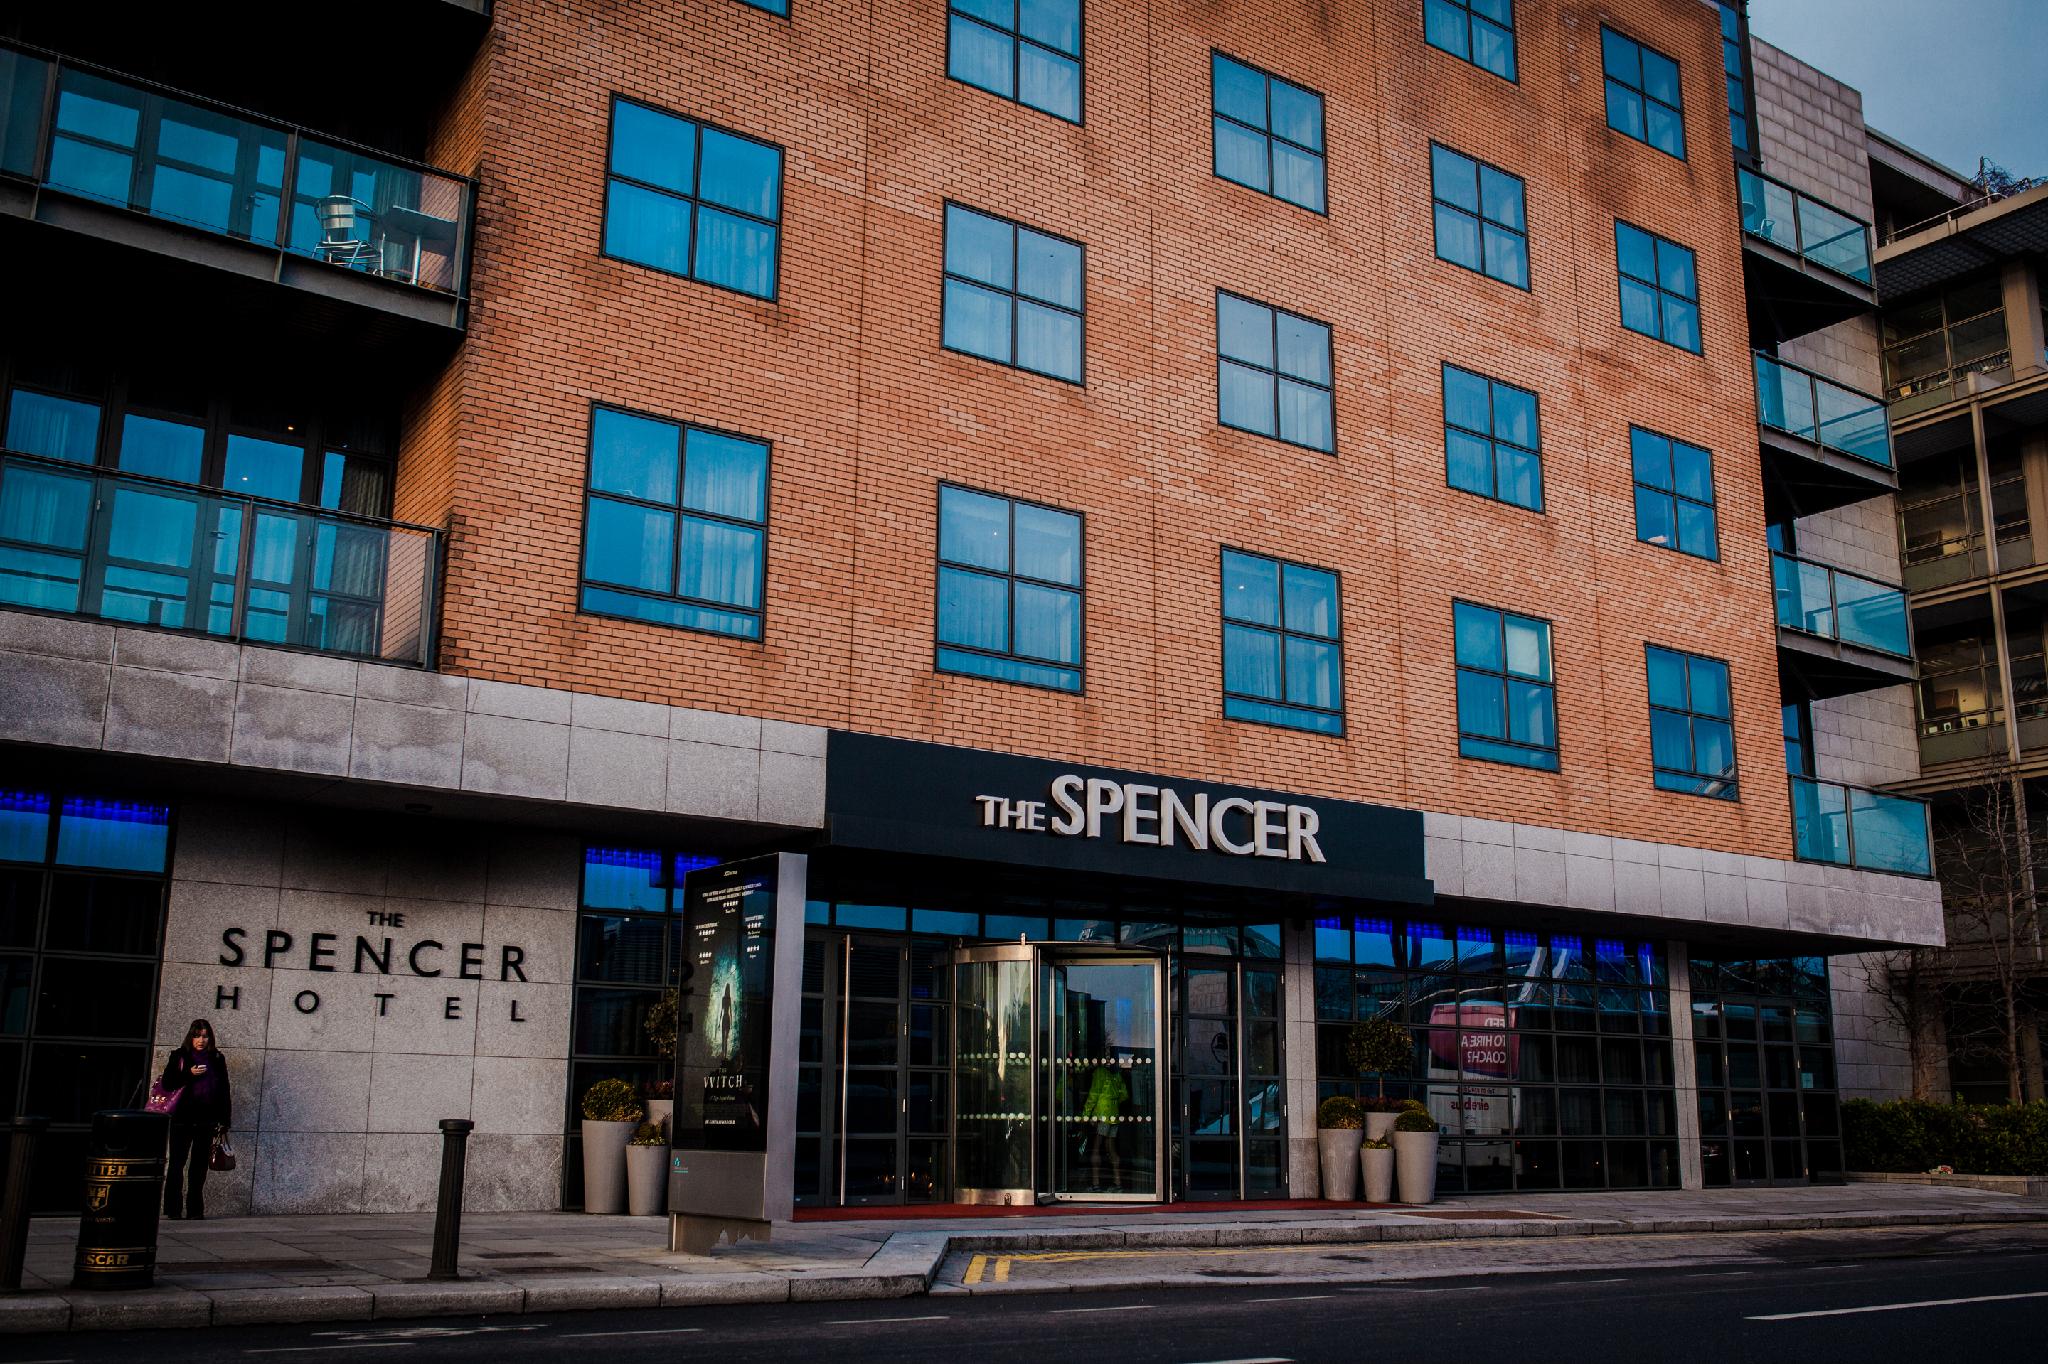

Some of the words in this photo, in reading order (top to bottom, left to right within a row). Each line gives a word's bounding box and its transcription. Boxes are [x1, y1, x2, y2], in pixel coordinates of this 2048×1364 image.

[975, 793, 1046, 832] THE
[1050, 774, 1327, 864] SPENCER
[366, 910, 406, 928] THE
[219, 927, 528, 982] SPENCER
[215, 985, 526, 1022] HOTEL
